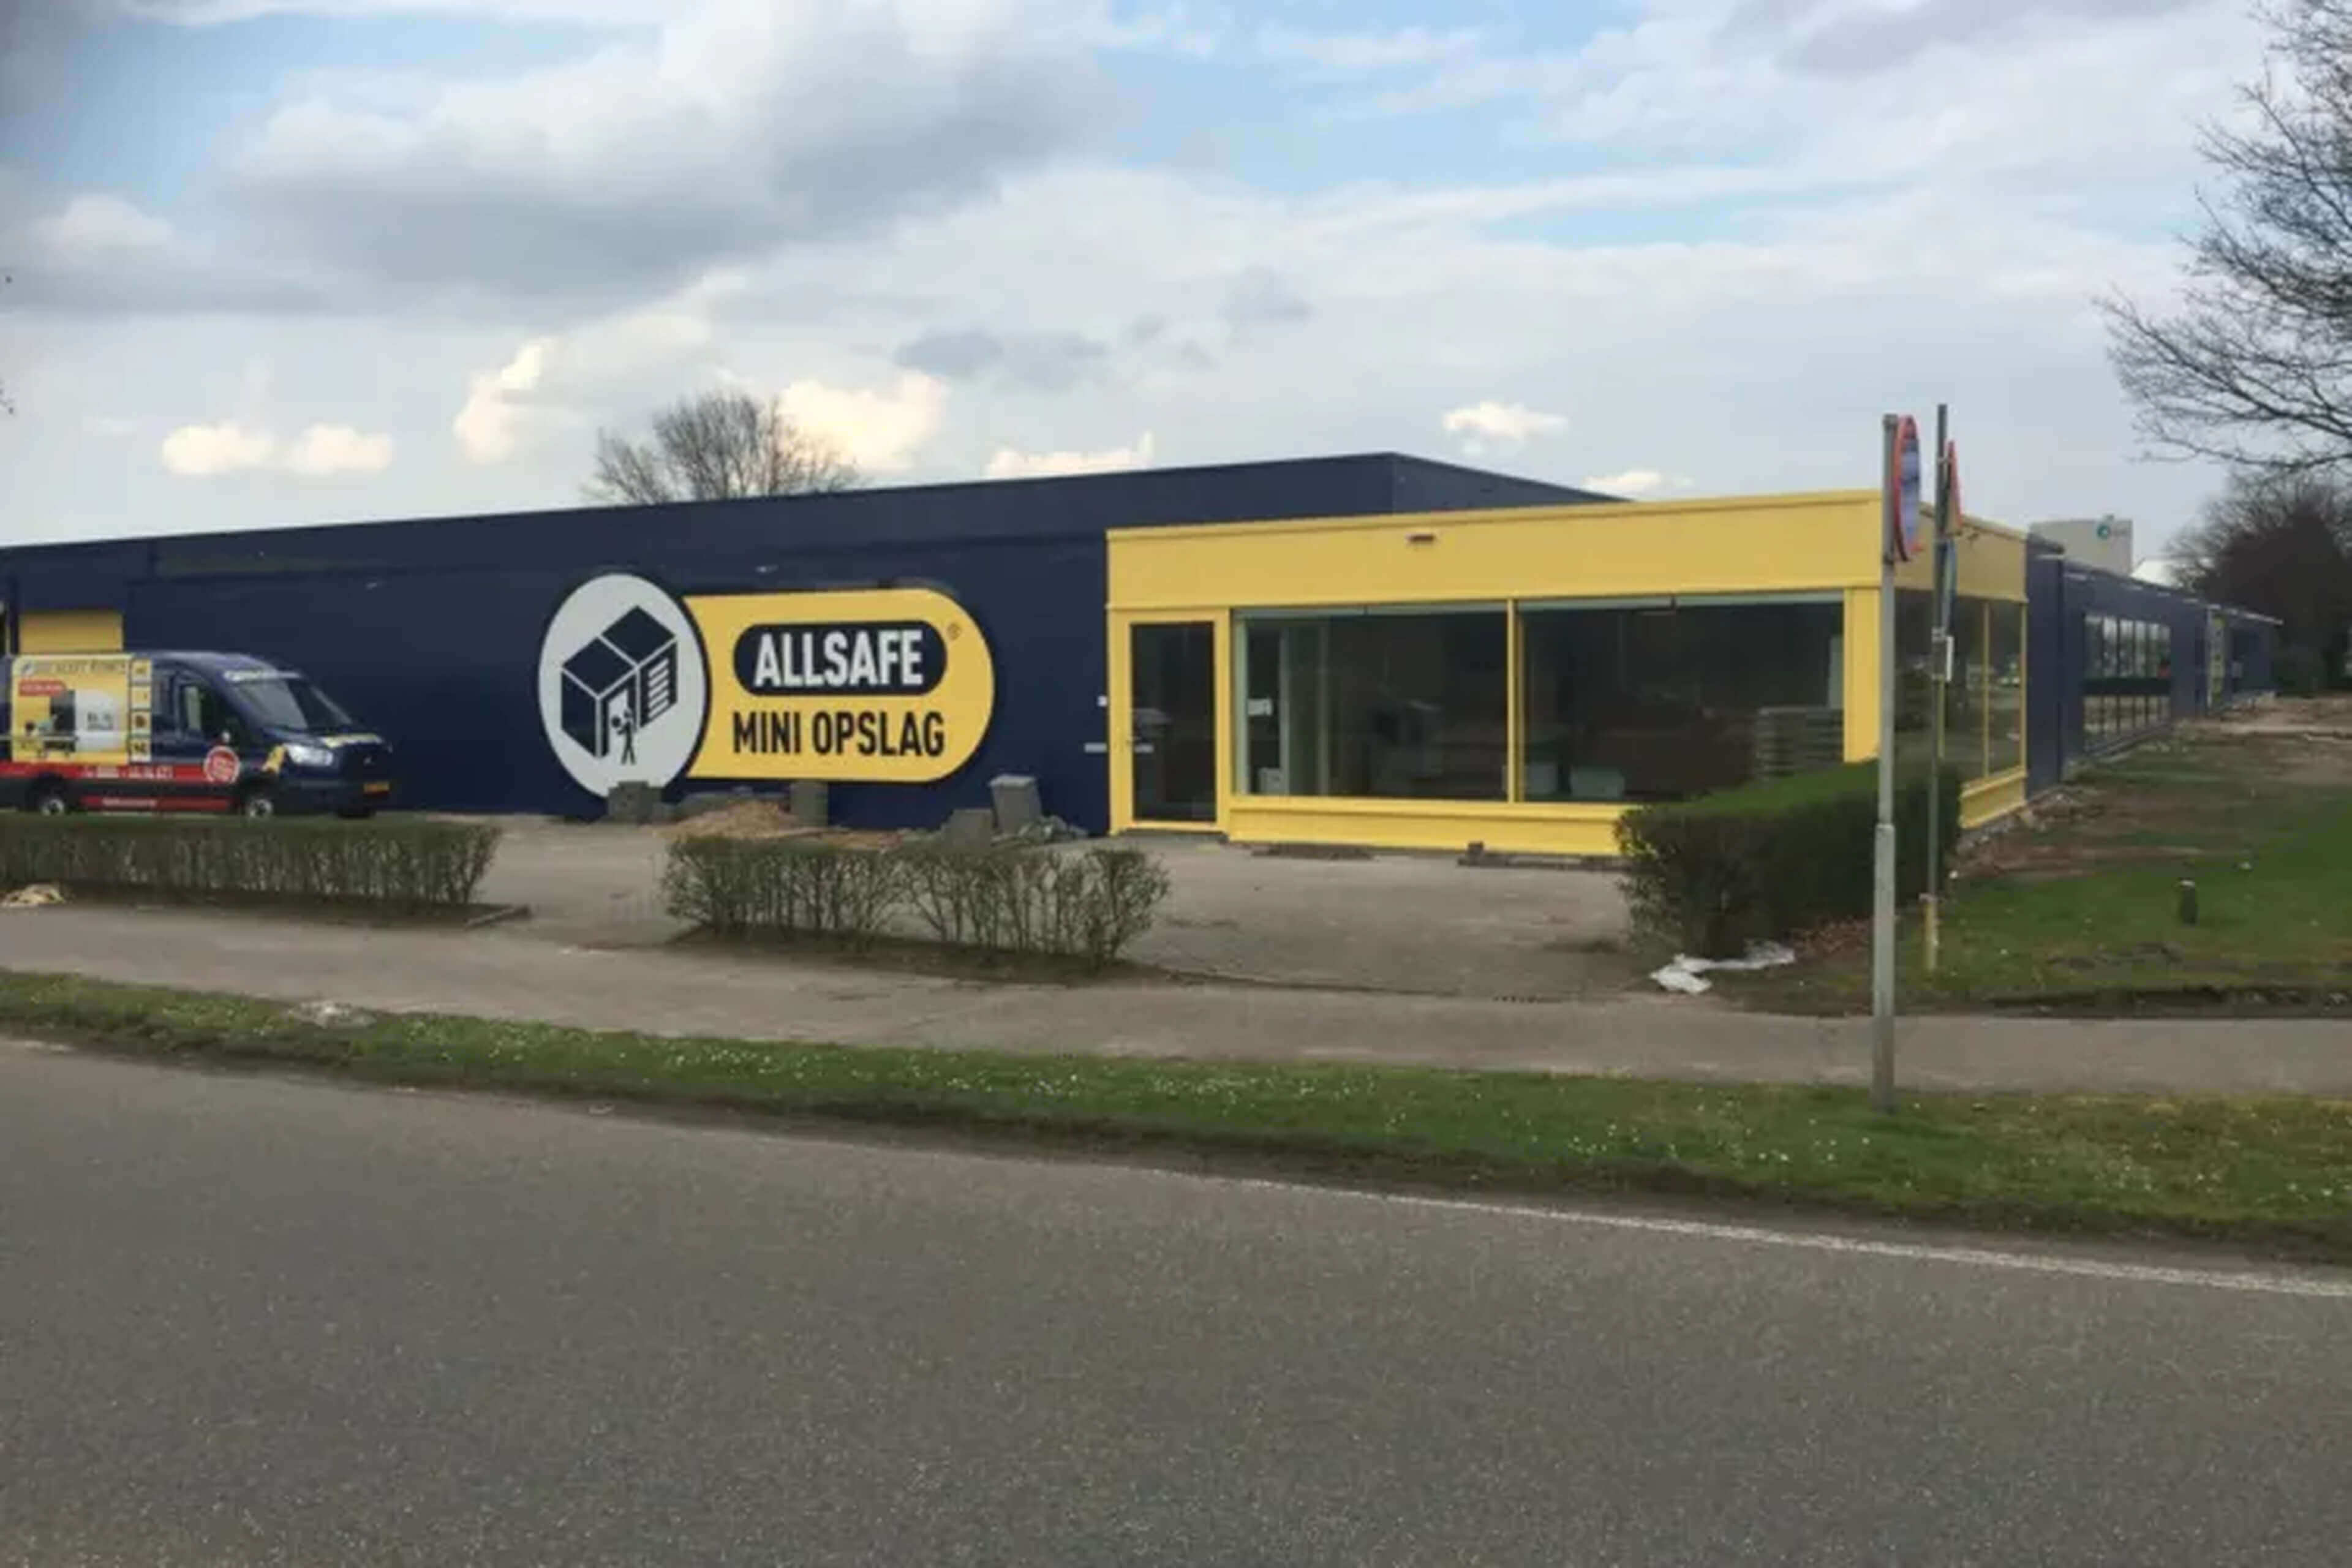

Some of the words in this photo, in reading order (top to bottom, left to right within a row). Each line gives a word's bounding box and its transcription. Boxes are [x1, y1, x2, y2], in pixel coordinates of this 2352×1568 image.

[754, 630, 924, 687] ALLSAFE
[733, 711, 801, 754] MINI
[812, 710, 944, 757] OPSLAG
